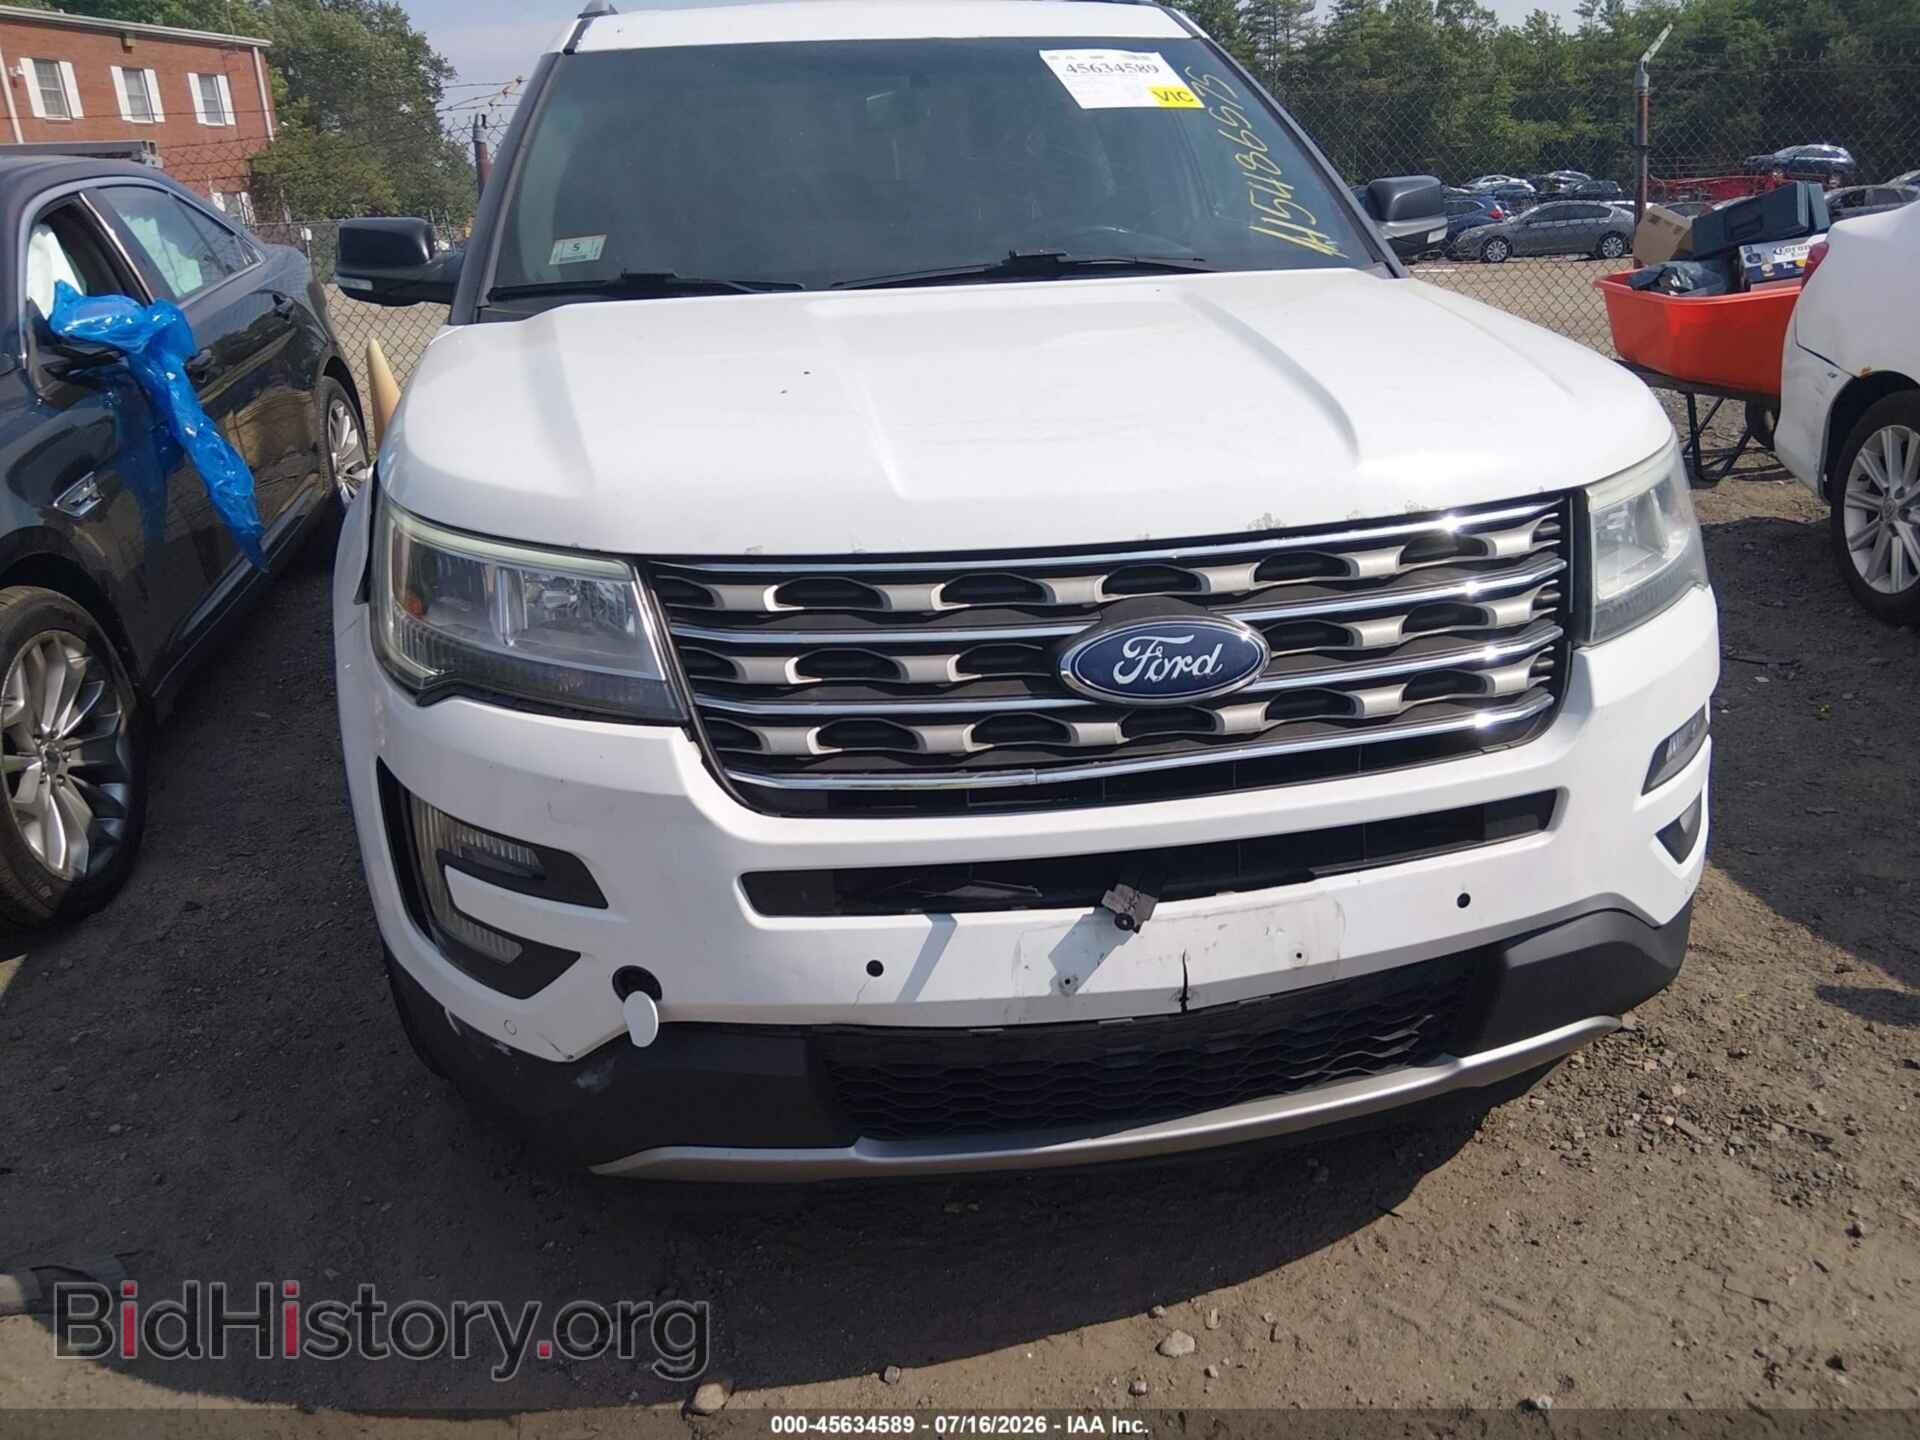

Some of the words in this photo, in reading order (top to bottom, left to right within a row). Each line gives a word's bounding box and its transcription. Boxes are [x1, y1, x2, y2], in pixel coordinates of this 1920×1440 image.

[1066, 63, 1159, 74] 45634589
[1152, 89, 1194, 103] VIC
[1112, 634, 1224, 685] Ford
